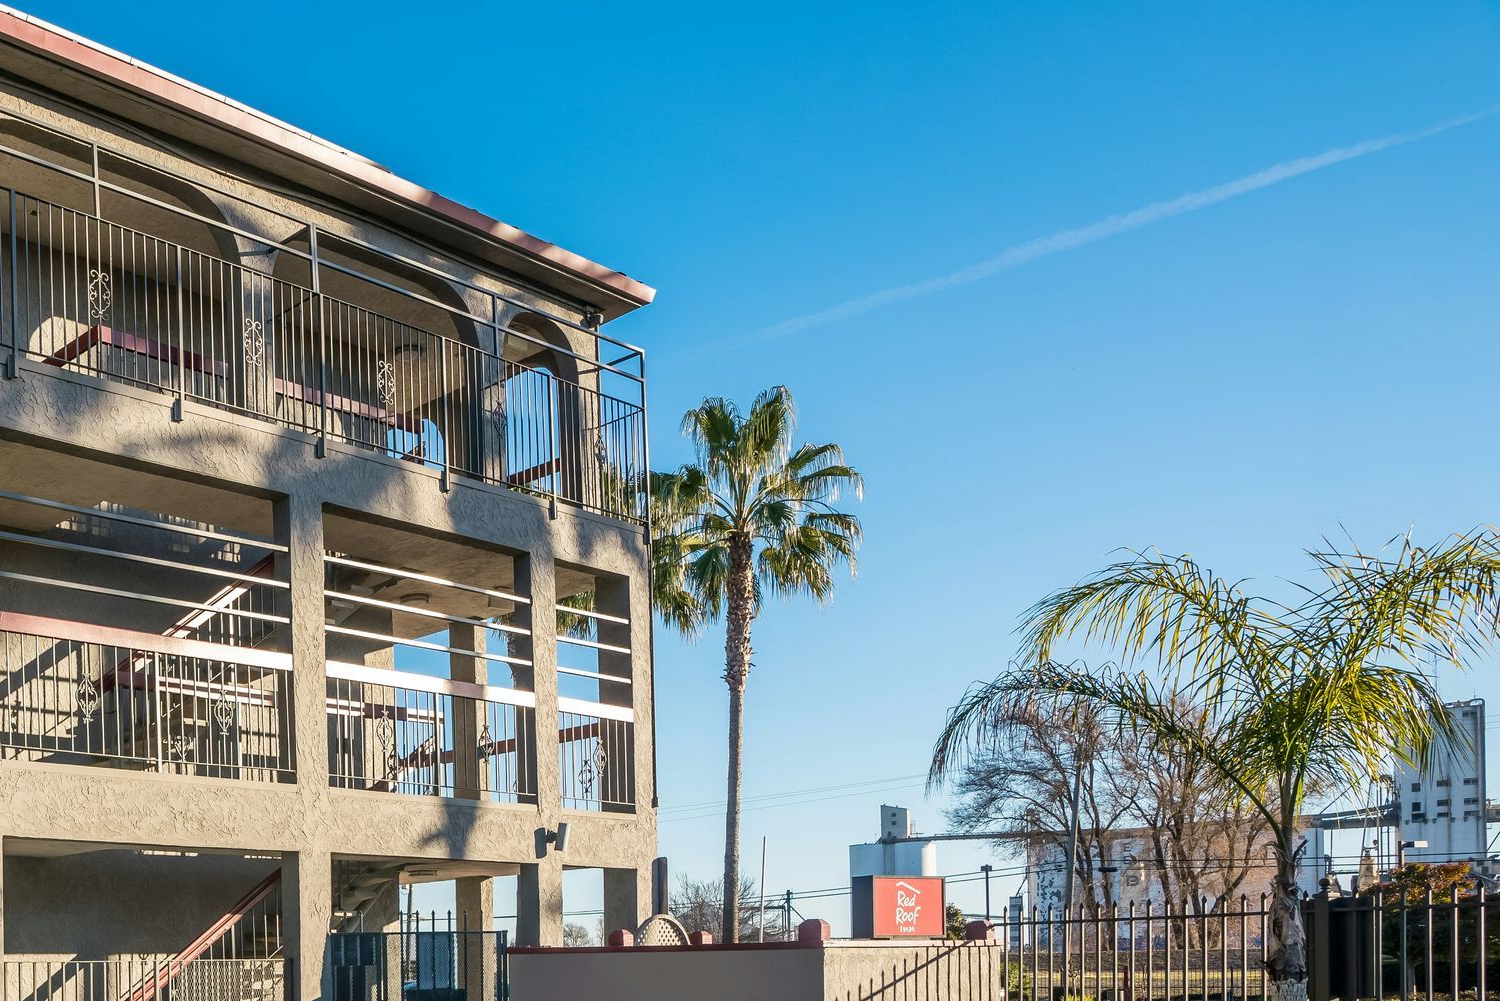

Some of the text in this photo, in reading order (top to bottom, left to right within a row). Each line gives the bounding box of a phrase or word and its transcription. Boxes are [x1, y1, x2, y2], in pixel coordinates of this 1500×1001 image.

[897, 891, 916, 907] Red
[896, 907, 921, 925] Roof
[900, 925, 915, 933] Inn
